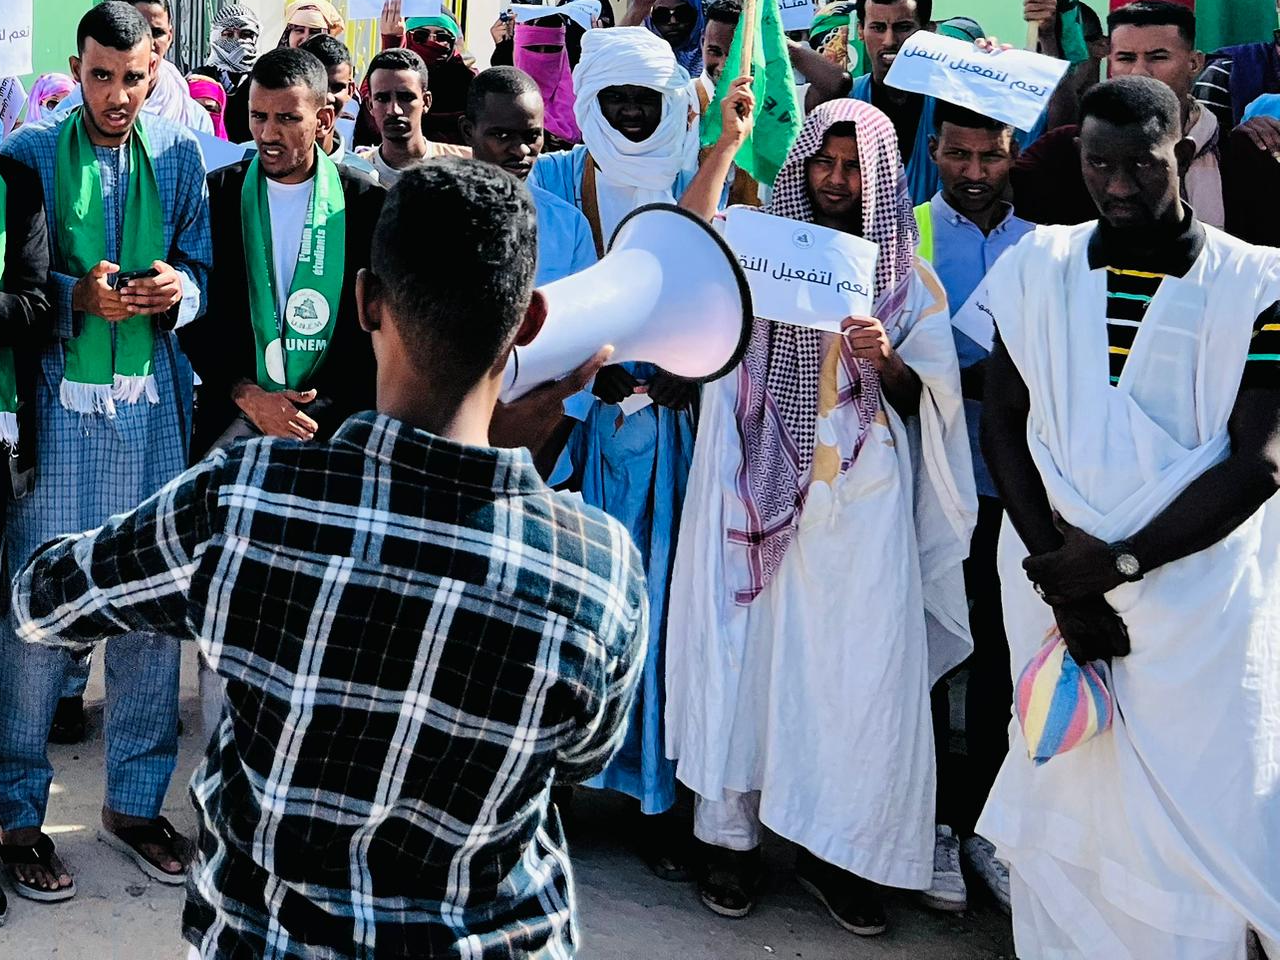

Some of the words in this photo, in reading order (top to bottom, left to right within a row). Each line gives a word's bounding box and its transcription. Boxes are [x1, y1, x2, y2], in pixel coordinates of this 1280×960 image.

[9, 25, 30, 43] نعم
[949, 59, 1009, 83] لتفعيل
[1009, 79, 1048, 97] نعم
[739, 255, 768, 273] النق
[772, 262, 832, 286] لتفعيل
[837, 280, 869, 296] نعم
[285, 339, 327, 351] UNEM
